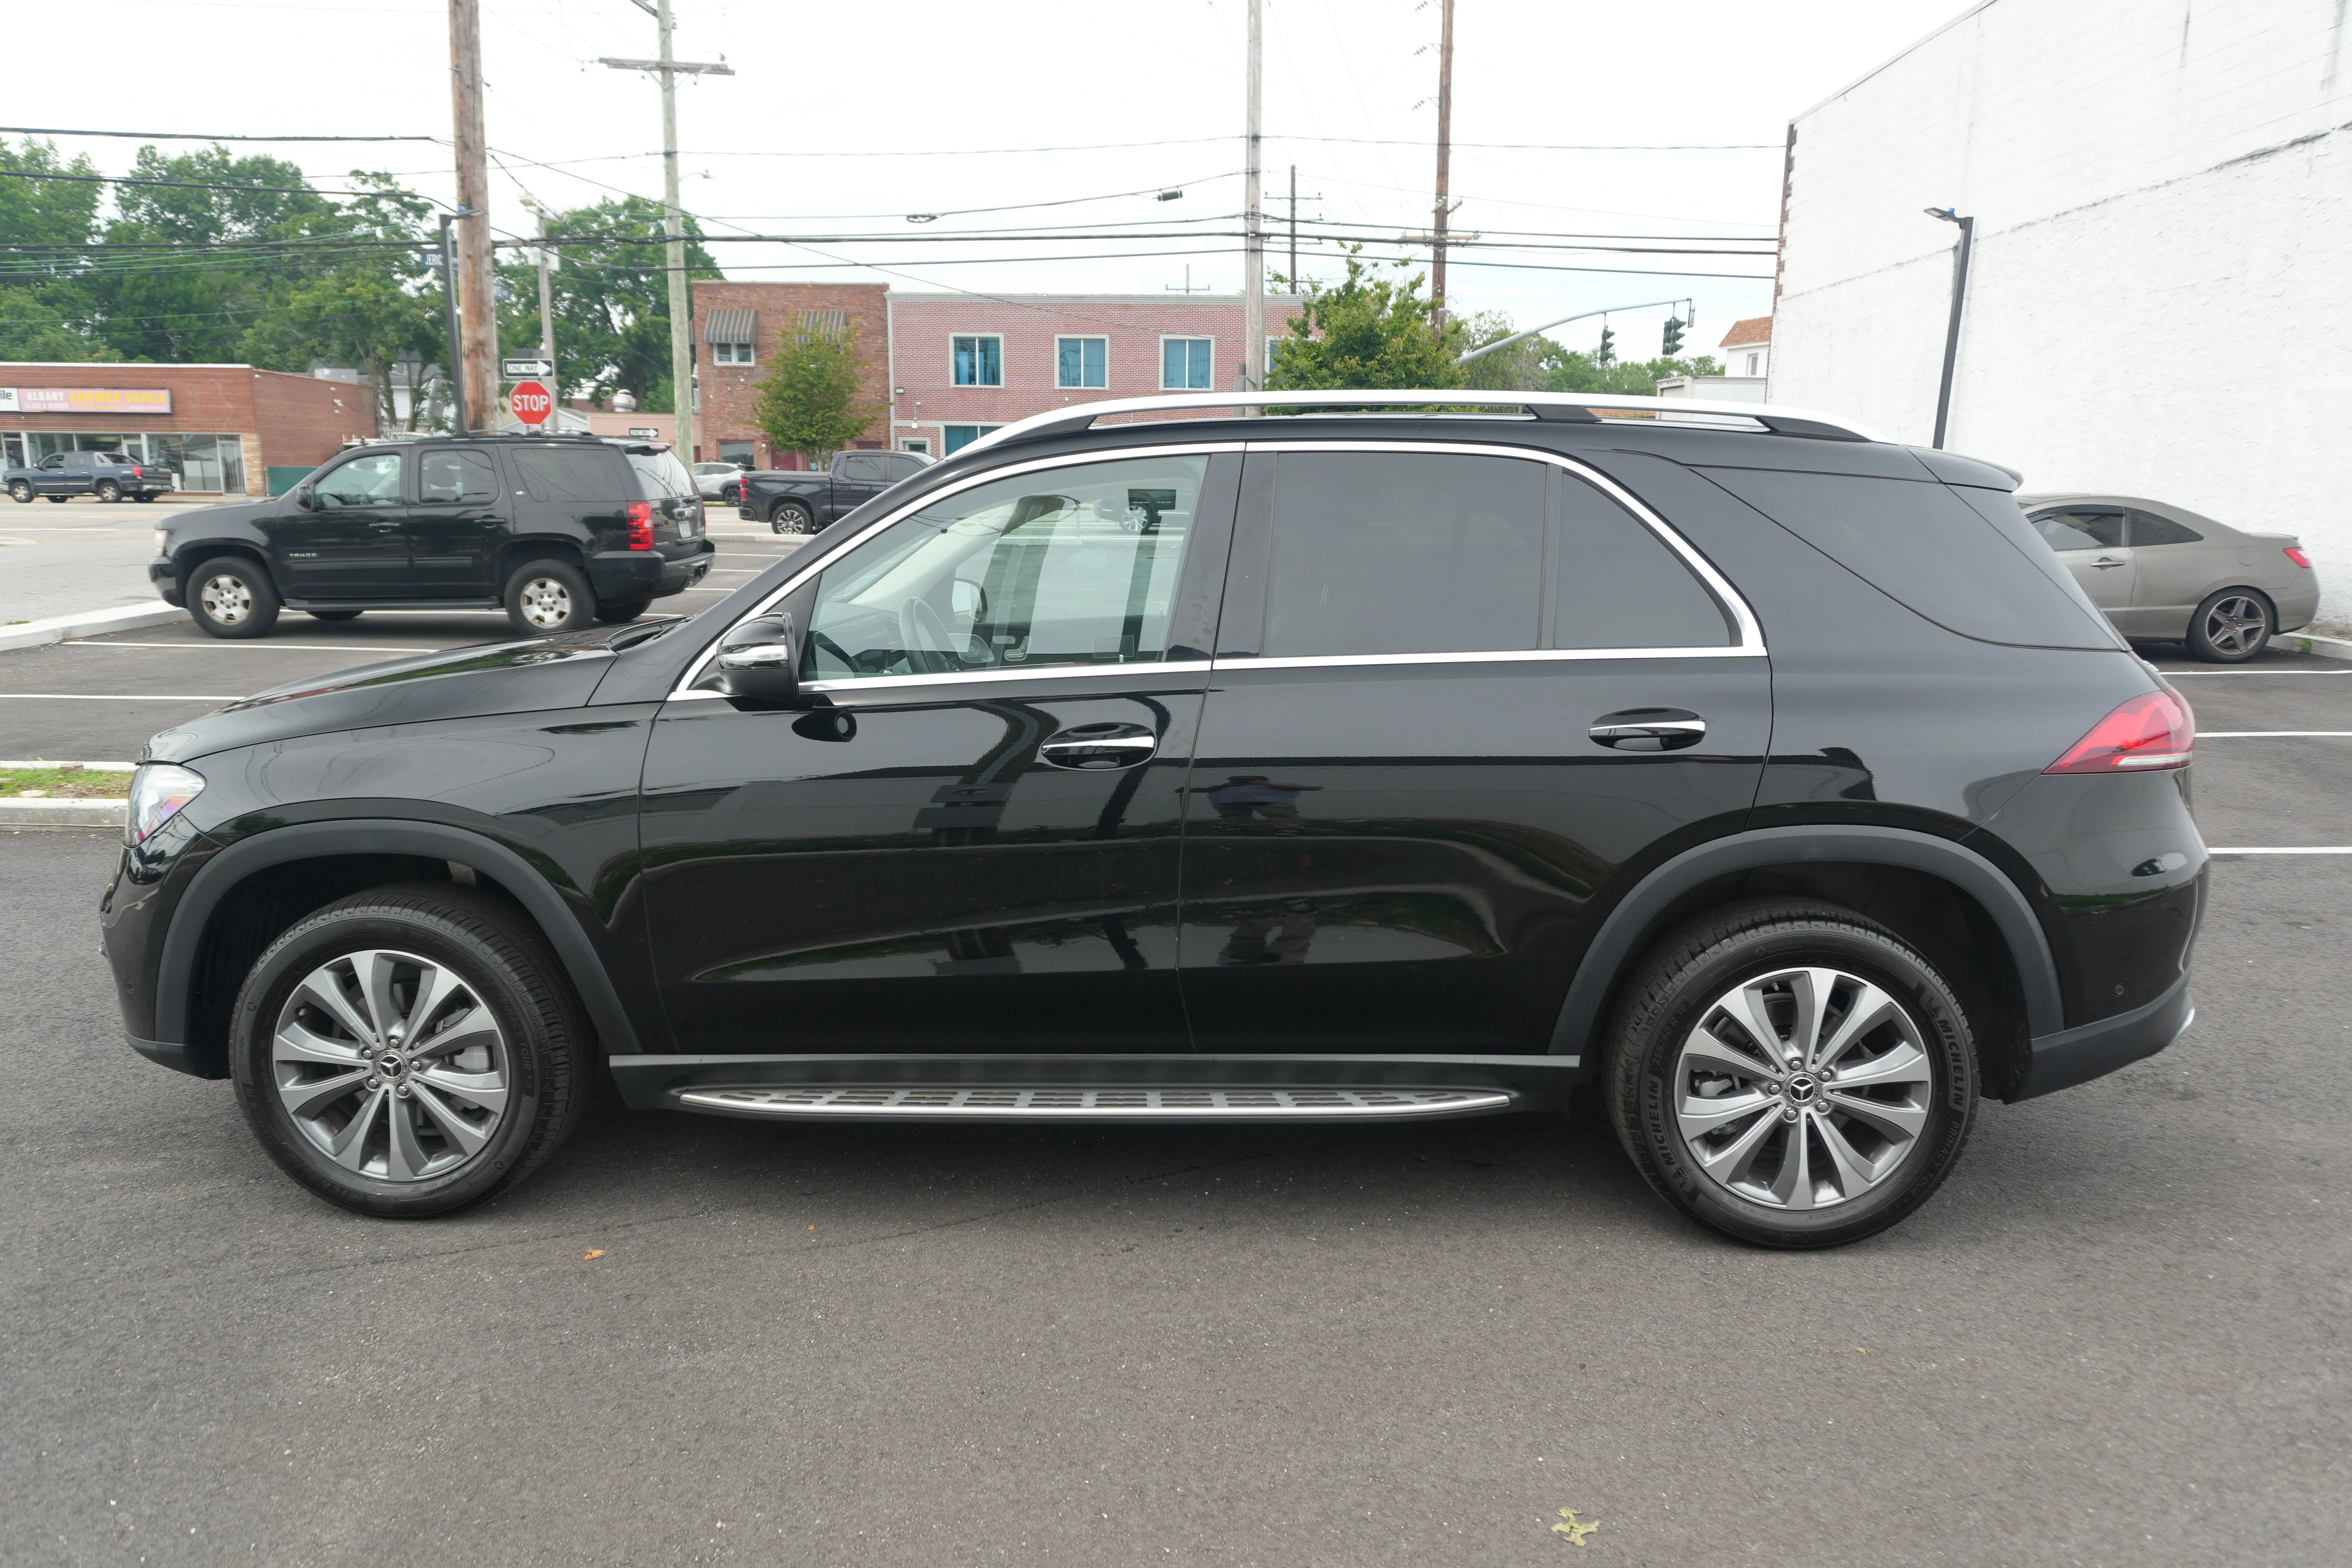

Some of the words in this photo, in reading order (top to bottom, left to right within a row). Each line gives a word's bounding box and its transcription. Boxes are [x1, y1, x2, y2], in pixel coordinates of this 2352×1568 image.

[425, 254, 443, 265] JERIC
[27, 392, 64, 401] ALBANY
[70, 392, 122, 403] SHOWER
[125, 392, 166, 403] DOORS
[513, 394, 548, 411] STOP
[519, 1042, 531, 1071] TOUR
[1653, 1027, 1672, 1066] 255/50
[1670, 1018, 1678, 1027] R
[1938, 1019, 1964, 1106] MICHELIN
[1648, 1080, 1676, 1166] MICHELIN
[1934, 1120, 1959, 1171] PRIMACY
[1909, 1172, 1935, 1197] TOUR
